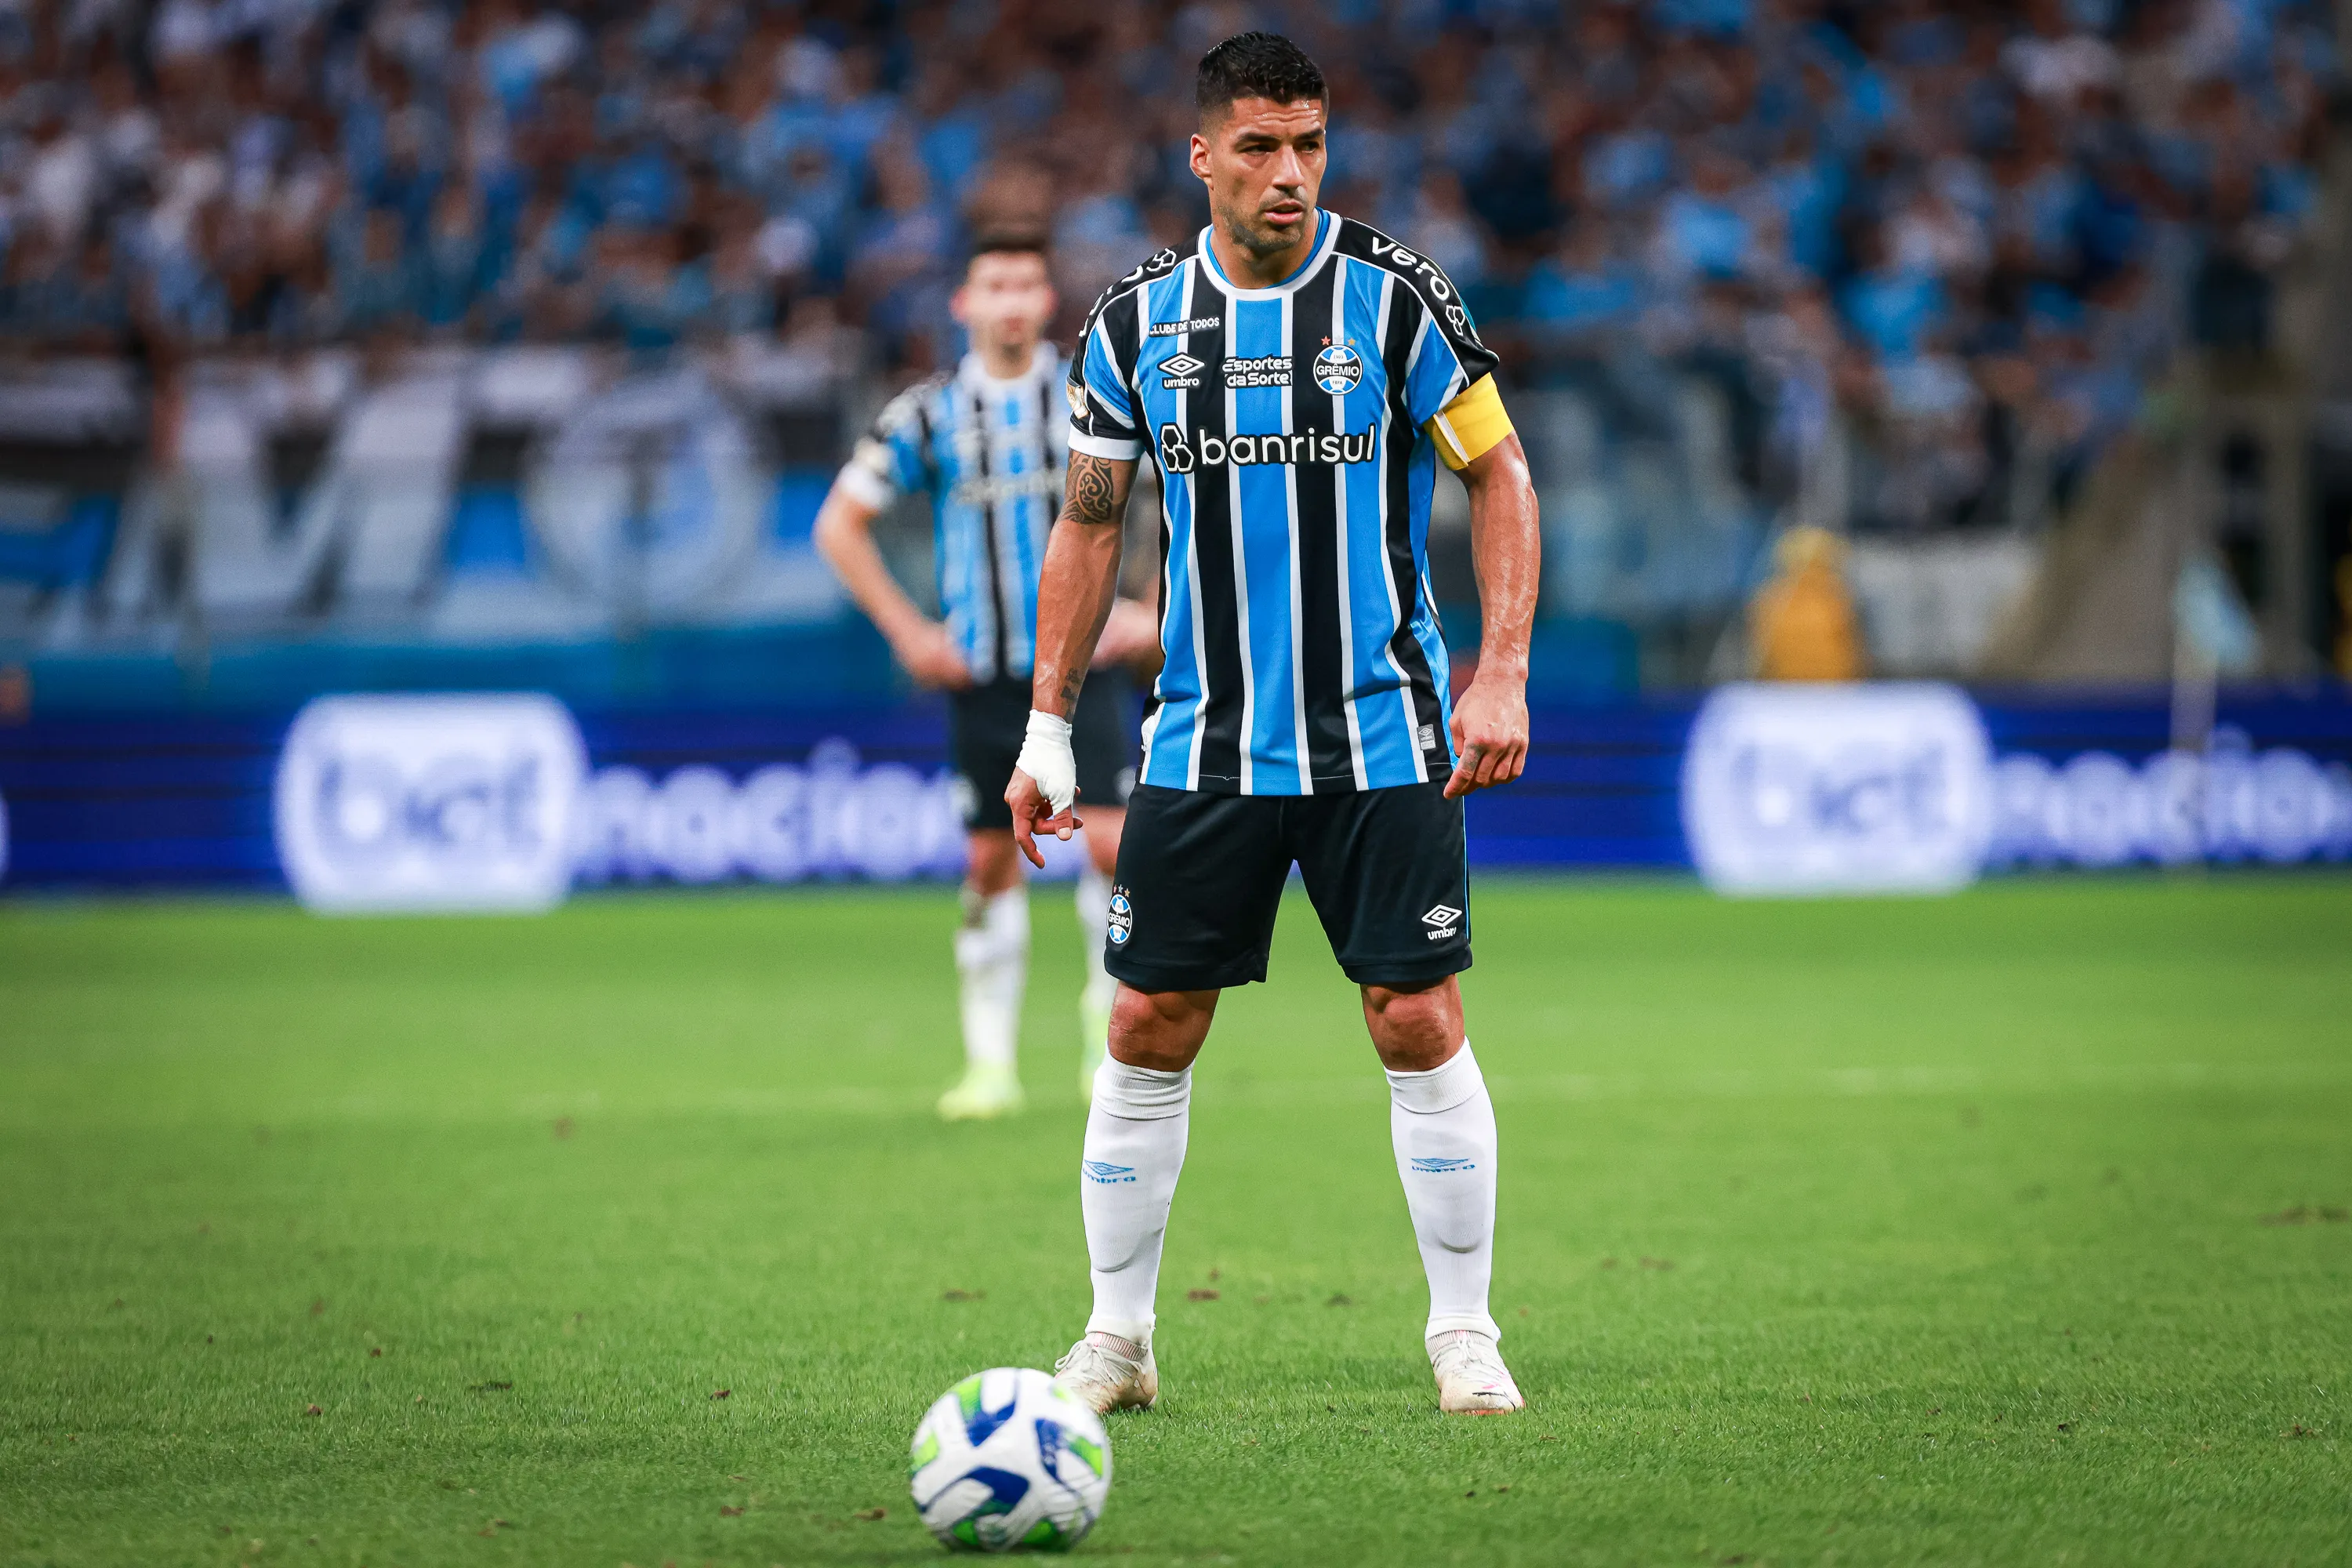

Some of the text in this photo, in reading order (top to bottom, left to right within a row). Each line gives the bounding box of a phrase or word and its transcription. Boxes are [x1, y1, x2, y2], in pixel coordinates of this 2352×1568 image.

[1372, 236, 1450, 301] vero
[1149, 317, 1220, 335] CLUBE DE TODOS
[1222, 357, 1293, 374] Esportes
[1316, 363, 1360, 376] GRÊMIO
[1163, 376, 1200, 388] umbro
[1199, 425, 1375, 465] banrisul
[1108, 912, 1131, 927] GRÊMIO
